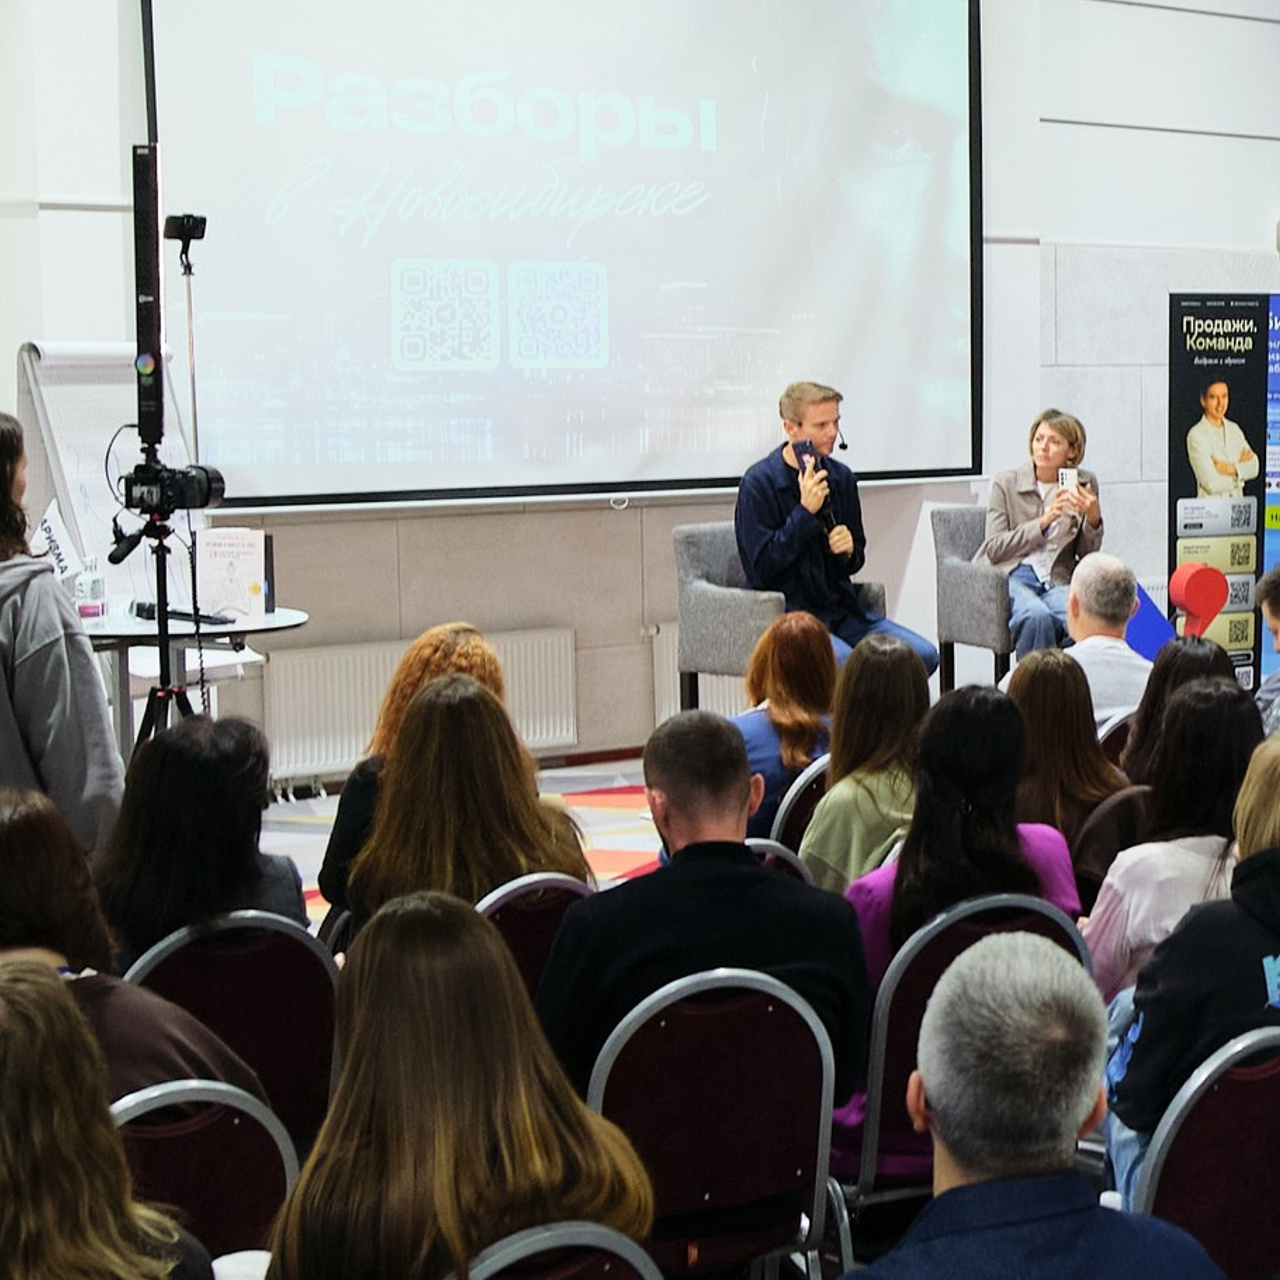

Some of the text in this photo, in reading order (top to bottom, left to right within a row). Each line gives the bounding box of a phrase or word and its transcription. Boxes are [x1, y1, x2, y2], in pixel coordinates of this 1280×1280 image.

[252, 52, 717, 158] Разборы
[330, 158, 714, 248] Новосибирске
[1182, 315, 1258, 338] Продажи.
[1186, 333, 1254, 353] Команда
